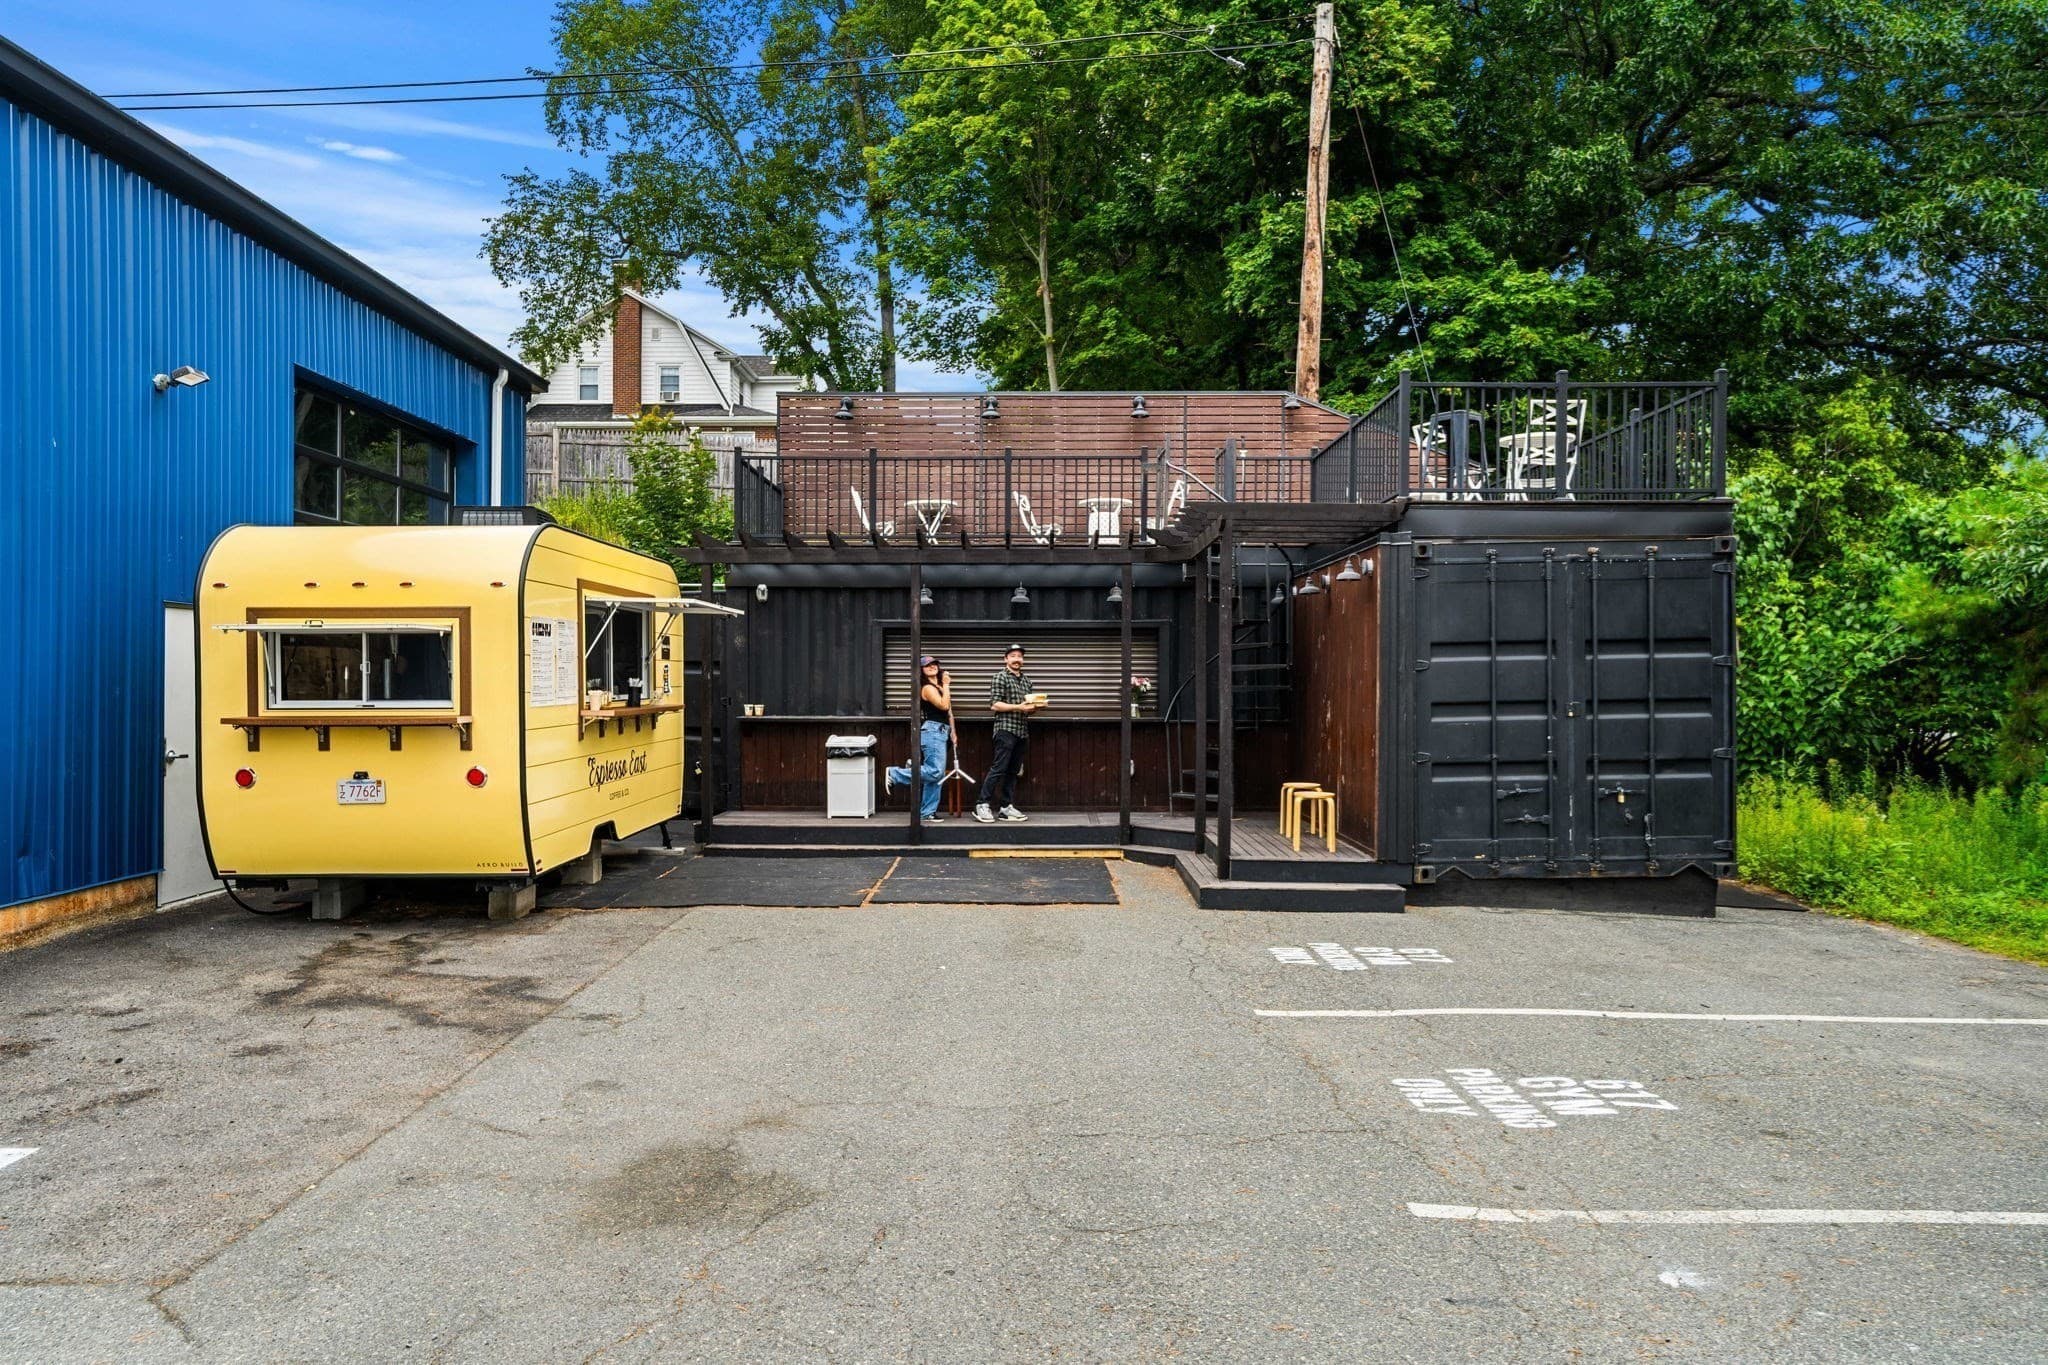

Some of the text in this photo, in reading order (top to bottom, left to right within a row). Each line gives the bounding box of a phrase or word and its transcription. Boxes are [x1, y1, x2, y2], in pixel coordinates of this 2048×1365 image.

[349, 785, 381, 798] 7762F
[587, 749, 648, 793] Espresso East
[1390, 1076, 1480, 1117] ONLY
[1443, 1067, 1558, 1129] PARKING
[1517, 1075, 1621, 1116] GYM
[1583, 1078, 1680, 1111] 617
